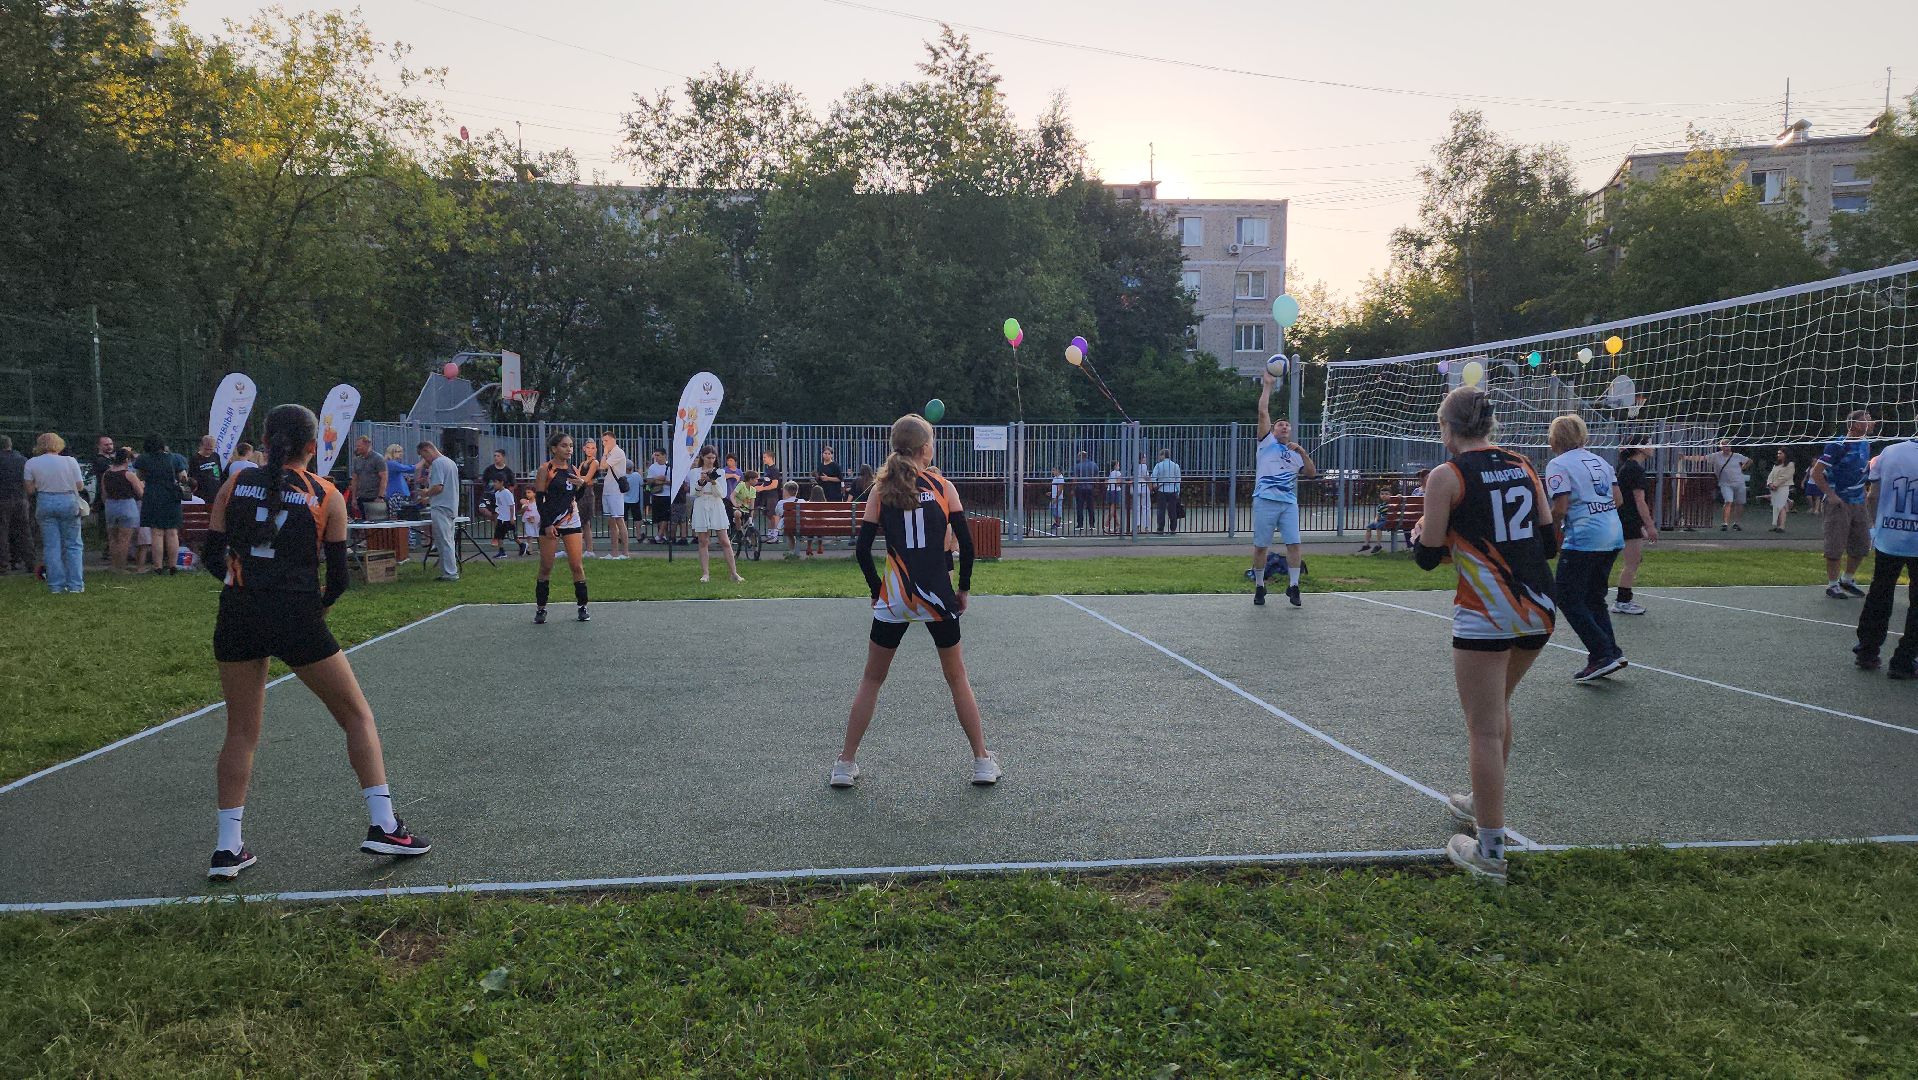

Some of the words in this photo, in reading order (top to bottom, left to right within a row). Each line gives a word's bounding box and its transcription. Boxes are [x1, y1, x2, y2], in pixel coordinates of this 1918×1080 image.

[1582, 458, 1610, 497] 5
[903, 507, 926, 549] 11
[1489, 485, 1534, 543] 12
